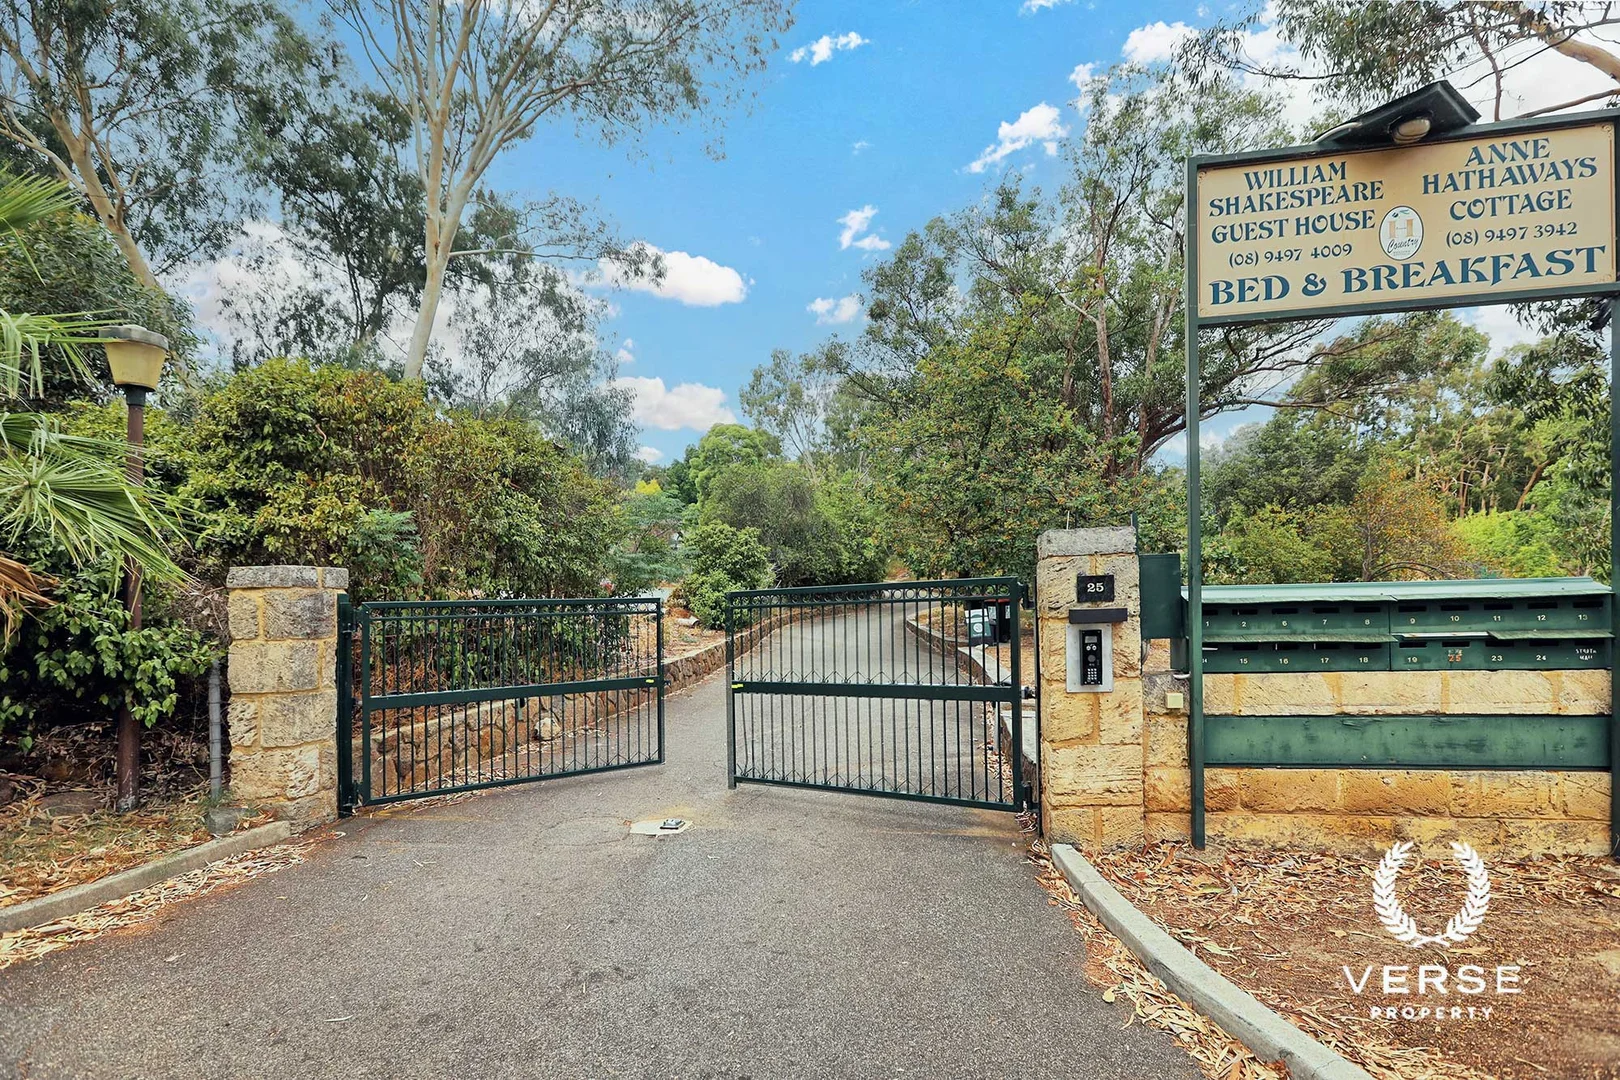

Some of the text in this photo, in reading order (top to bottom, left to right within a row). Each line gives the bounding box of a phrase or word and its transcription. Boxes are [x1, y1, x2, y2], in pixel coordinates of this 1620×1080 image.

[1465, 138, 1550, 166] ANNE
[1244, 161, 1347, 190] WILLIAM
[1422, 157, 1597, 194] HATHAWAYS
[1209, 180, 1384, 217] SHAKESPEARE
[1449, 188, 1572, 220] COTTAGE
[1211, 209, 1375, 243] GUEST HOUSE
[1446, 221, 1578, 248] (08) 9497 3942
[1229, 243, 1352, 268] (08) 9497 4009
[1209, 245, 1606, 305] BED & BREAKFAST
[1087, 582, 1104, 592] 25
